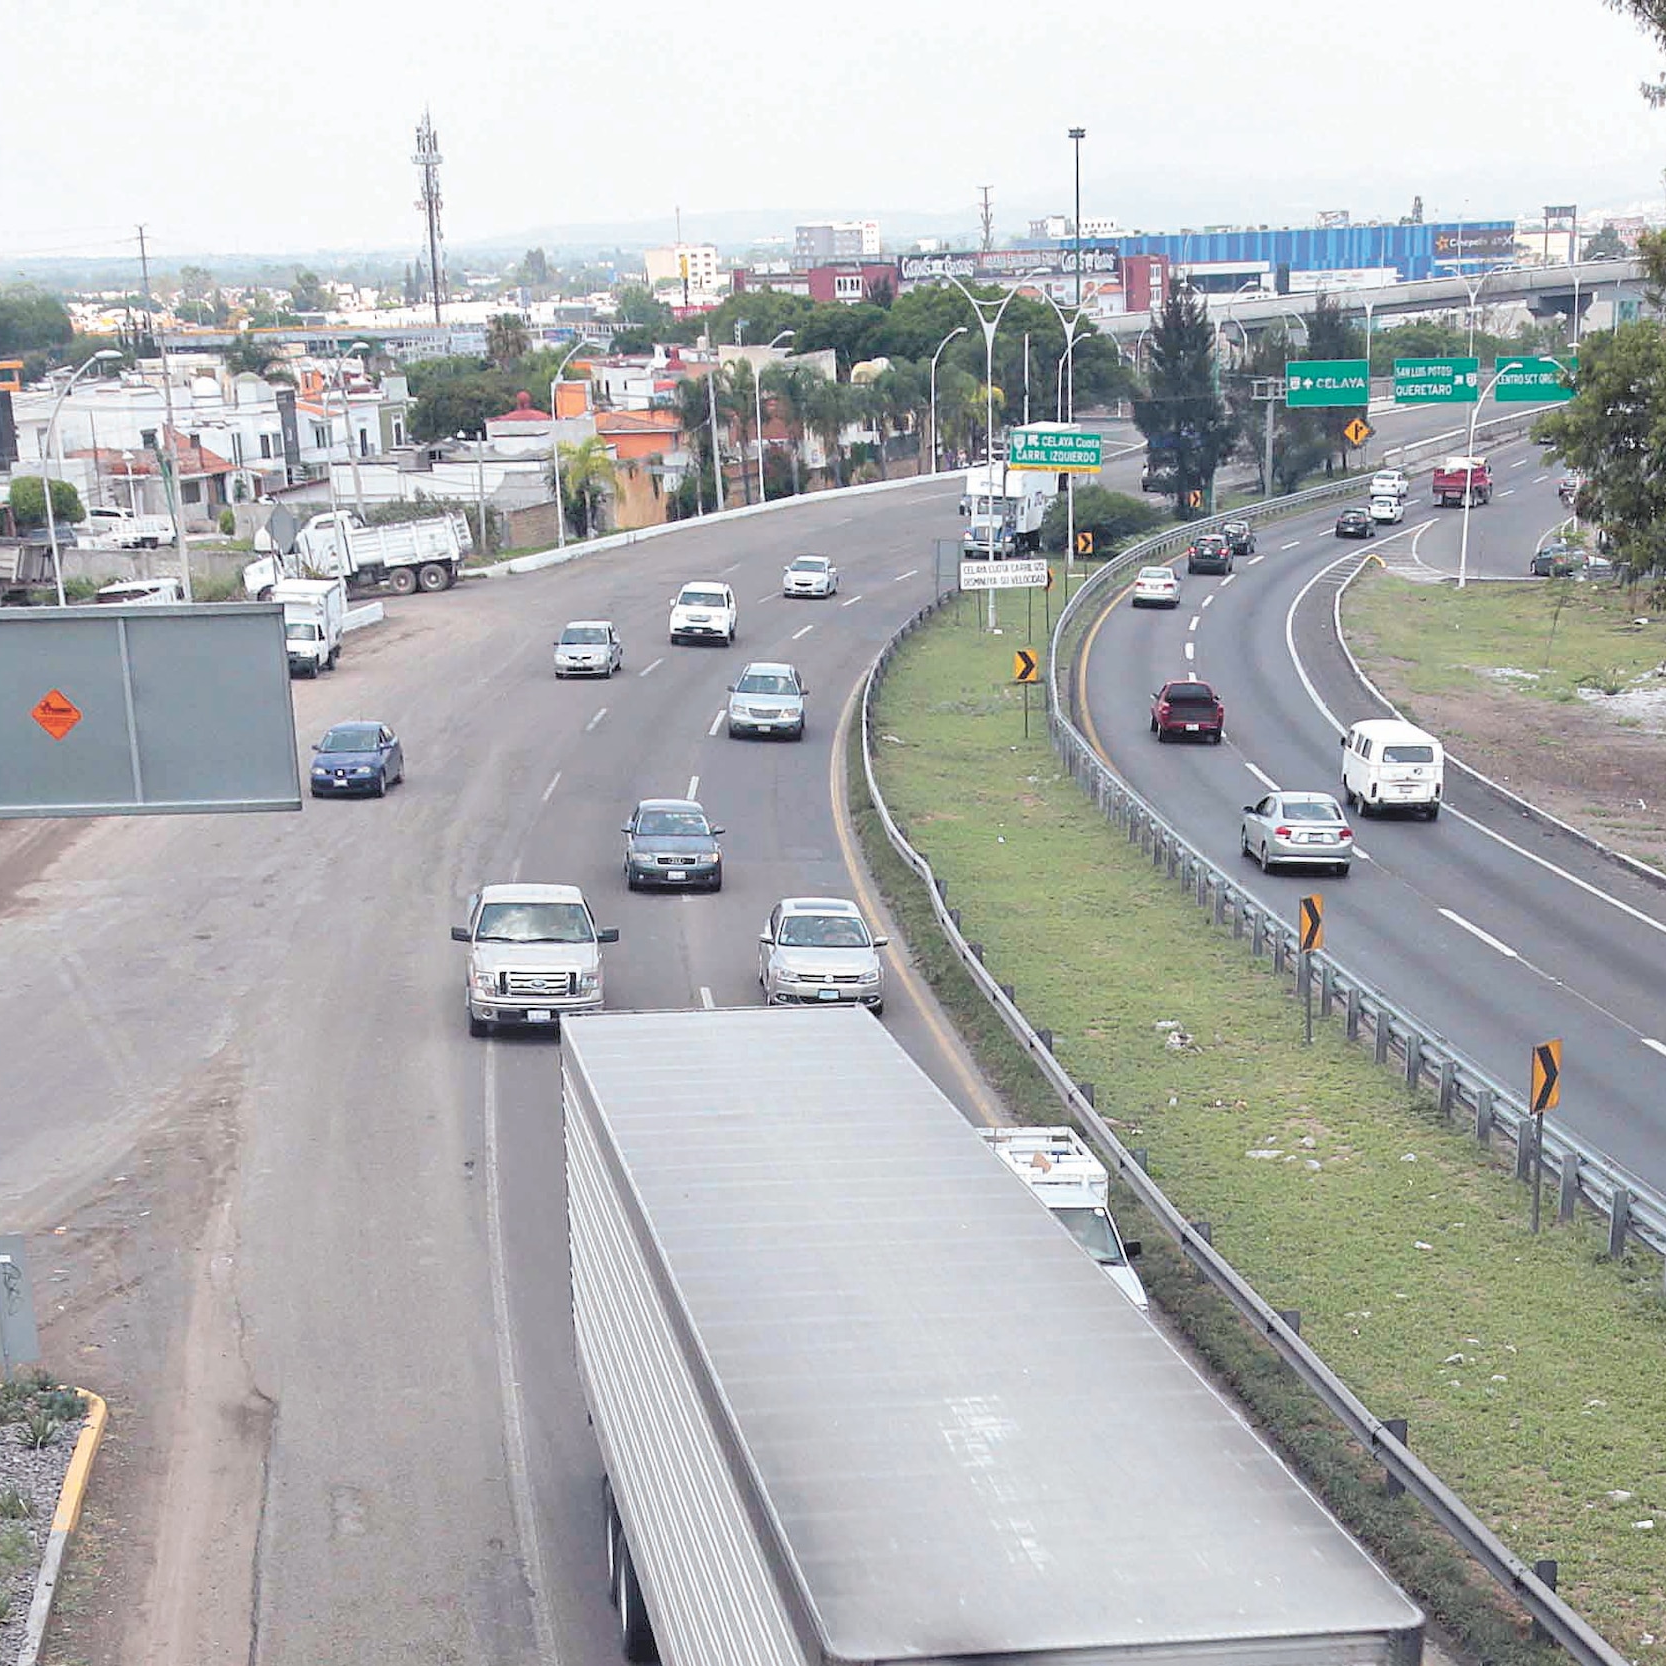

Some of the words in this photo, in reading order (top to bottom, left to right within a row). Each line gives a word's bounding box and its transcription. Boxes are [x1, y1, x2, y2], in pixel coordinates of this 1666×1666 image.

[1316, 377, 1365, 389] CELAYA
[1396, 384, 1452, 396] QUERETARO
[1042, 435, 1074, 447] CELAYA
[1016, 450, 1047, 461] CARRIL
[1050, 451, 1096, 463] IZQUIERDO
